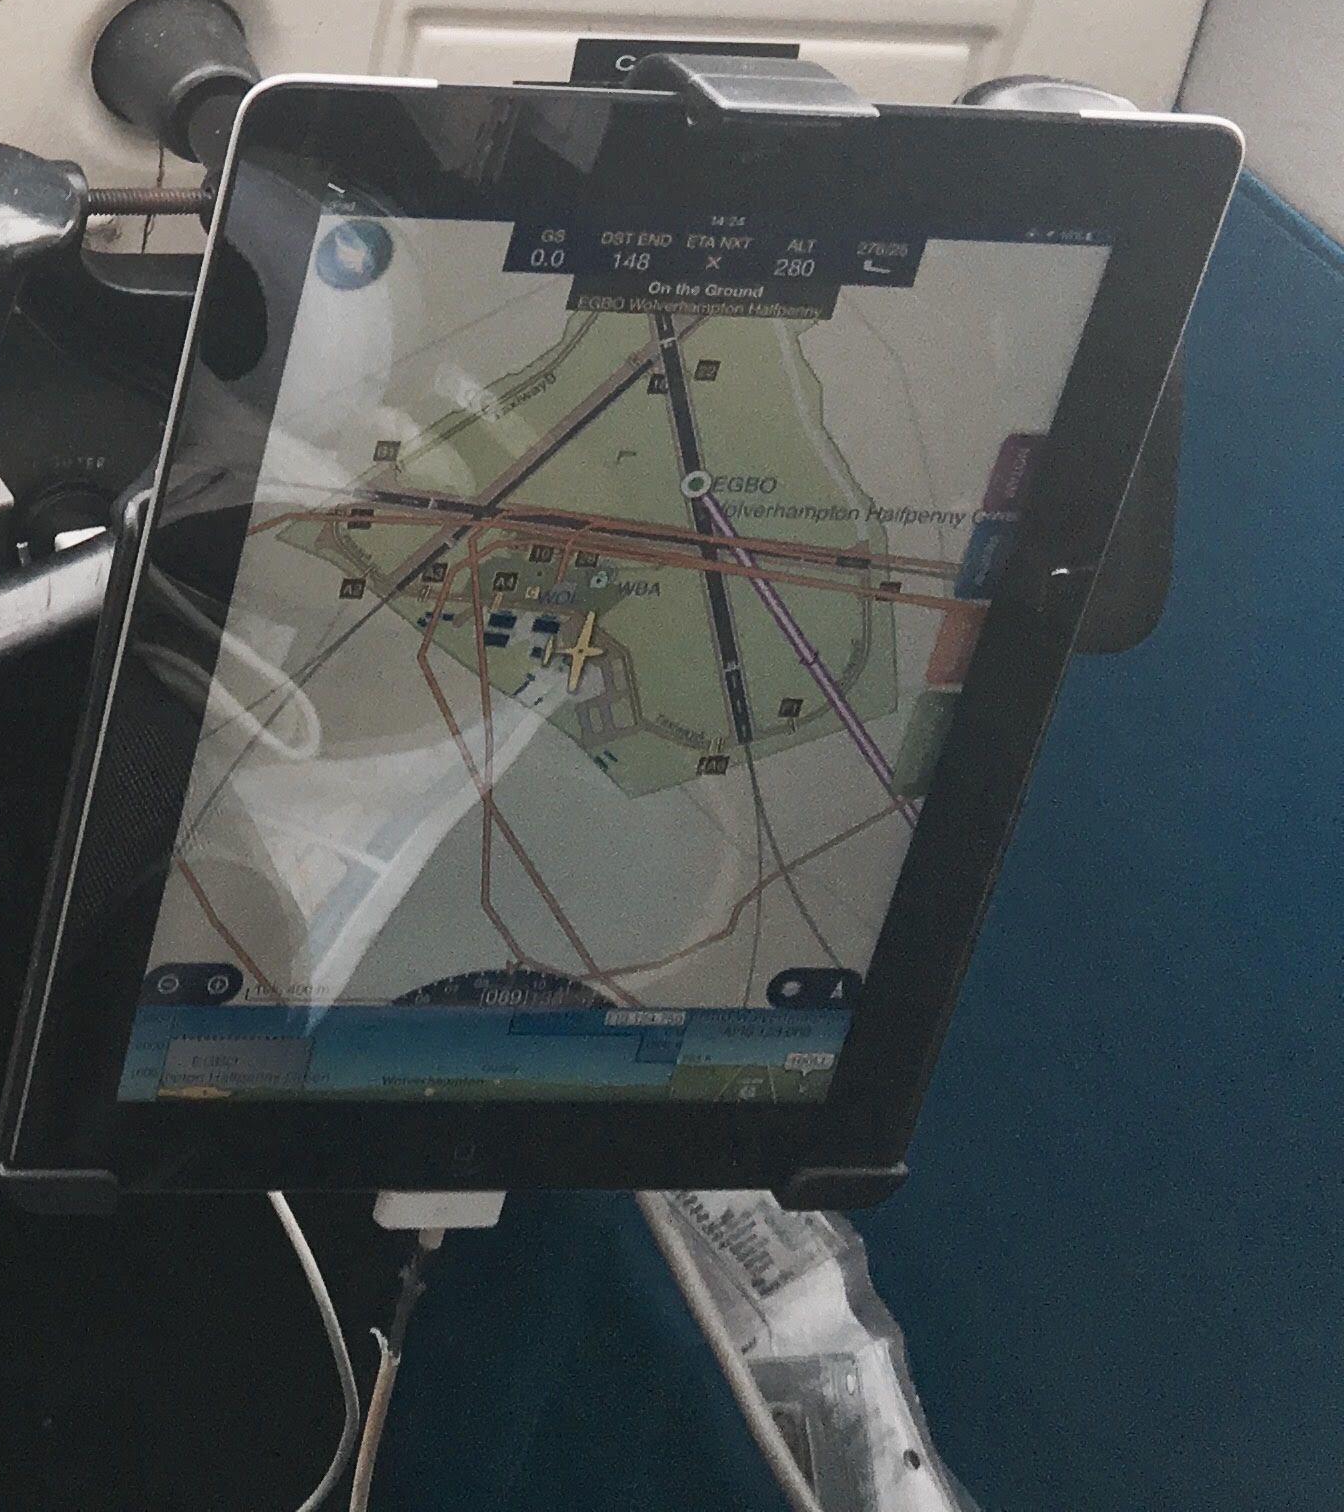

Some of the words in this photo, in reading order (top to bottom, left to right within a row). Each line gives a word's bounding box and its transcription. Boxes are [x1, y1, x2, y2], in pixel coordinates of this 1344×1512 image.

[531, 250, 564, 268] 0.0
[613, 252, 649, 271] 148
[774, 259, 814, 277] 280
[648, 281, 669, 296] On
[674, 284, 698, 296] the
[705, 285, 764, 299] Ground
[713, 476, 776, 494] EGBO
